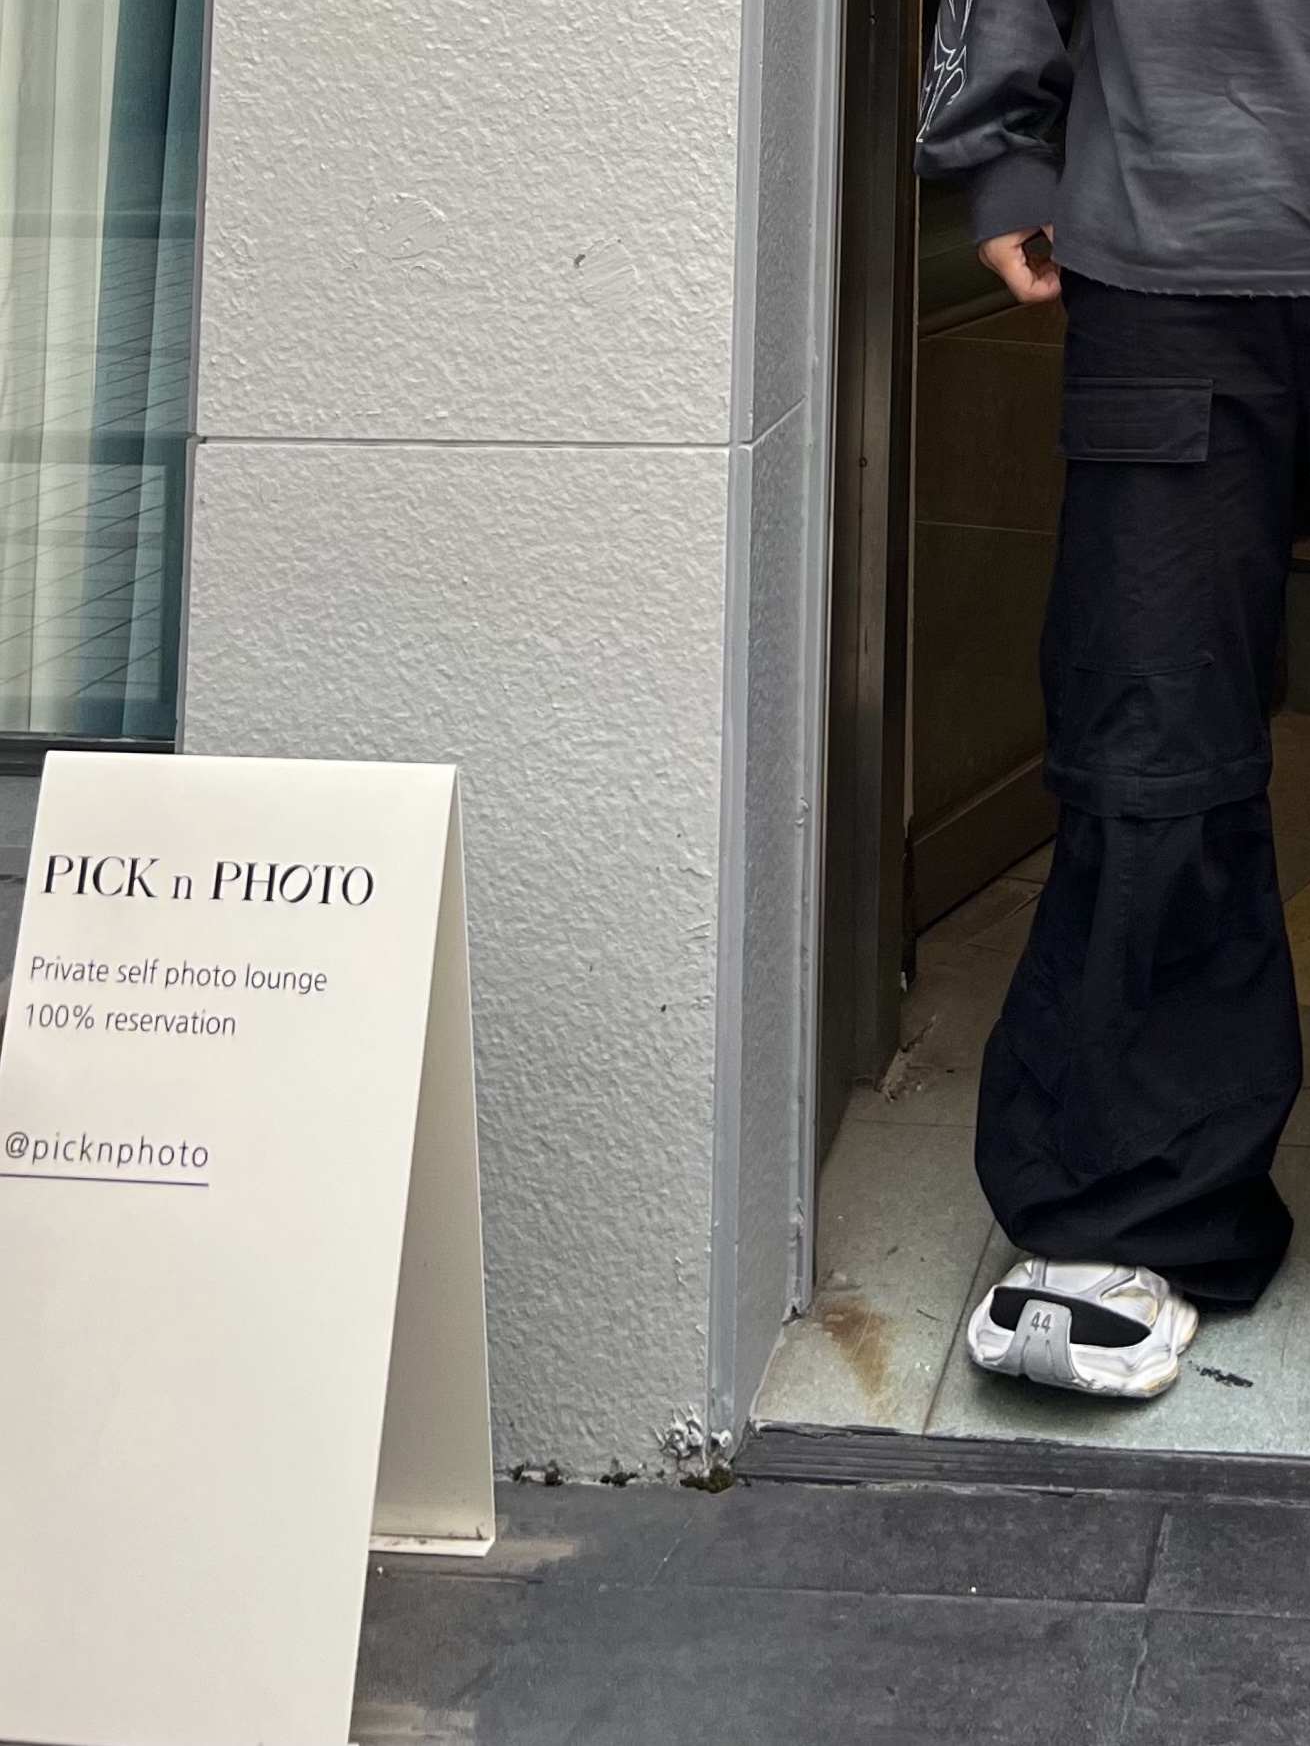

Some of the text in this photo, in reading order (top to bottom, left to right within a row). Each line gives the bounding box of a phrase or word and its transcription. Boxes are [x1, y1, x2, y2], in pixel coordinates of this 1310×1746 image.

[42, 854, 375, 906] PICK n PHOTO
[30, 955, 328, 995] Private self photo lounge
[26, 1003, 236, 1036] 100% reservation
[5, 1130, 209, 1169] @picknphoto
[1030, 1311, 1052, 1334] 44
